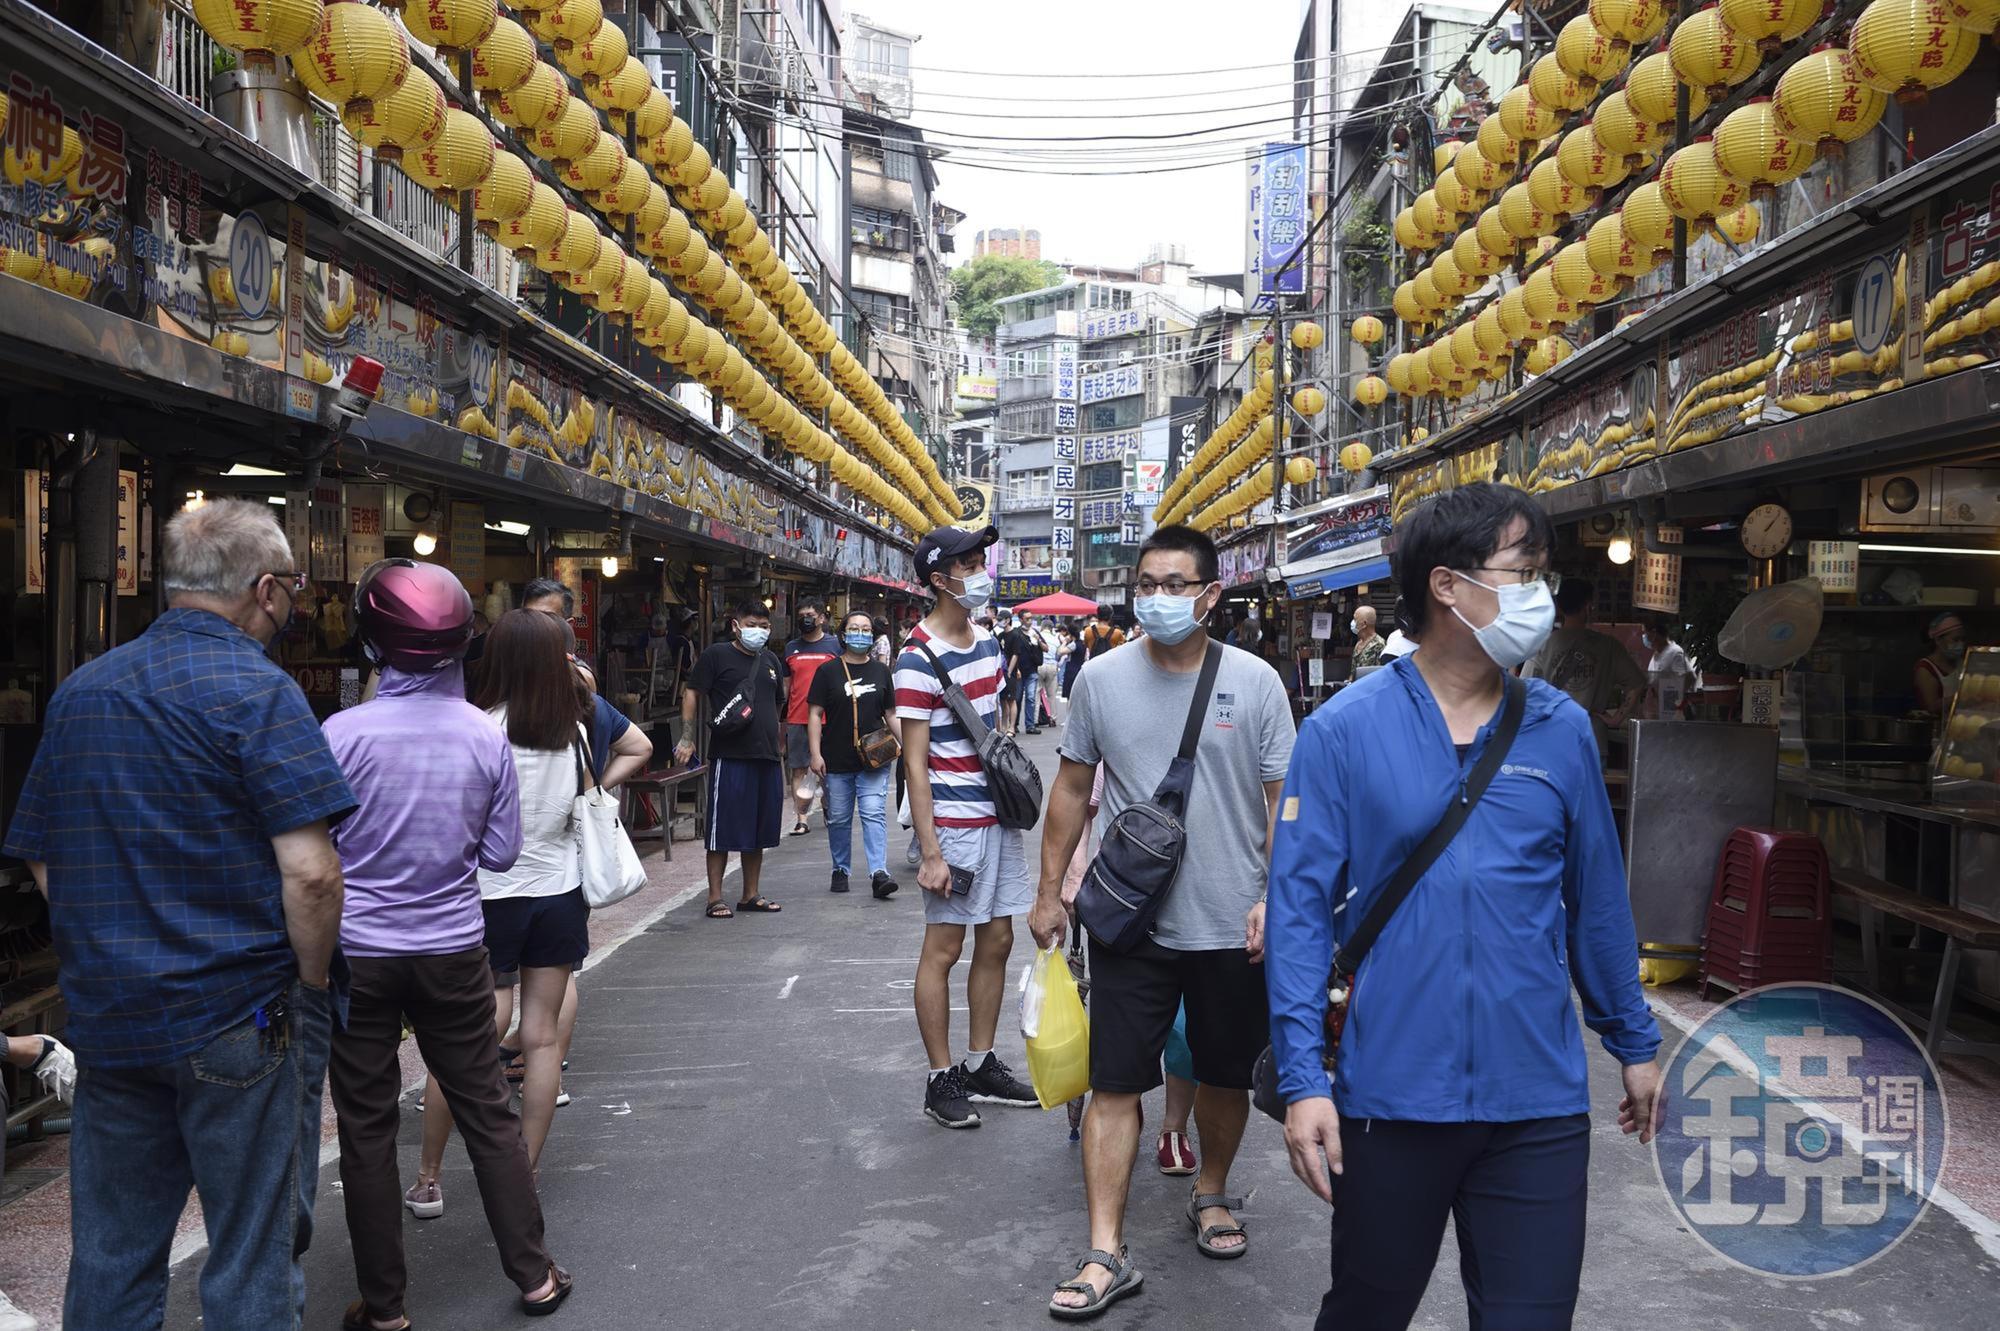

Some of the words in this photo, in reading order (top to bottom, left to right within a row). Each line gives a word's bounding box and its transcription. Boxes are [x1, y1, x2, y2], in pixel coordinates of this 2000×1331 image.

[1270, 165, 1299, 245] 刮刮樂
[238, 229, 264, 302] 20
[1861, 272, 1883, 338] 17
[294, 668, 334, 692] 0號
[713, 693, 743, 726] Supreme
